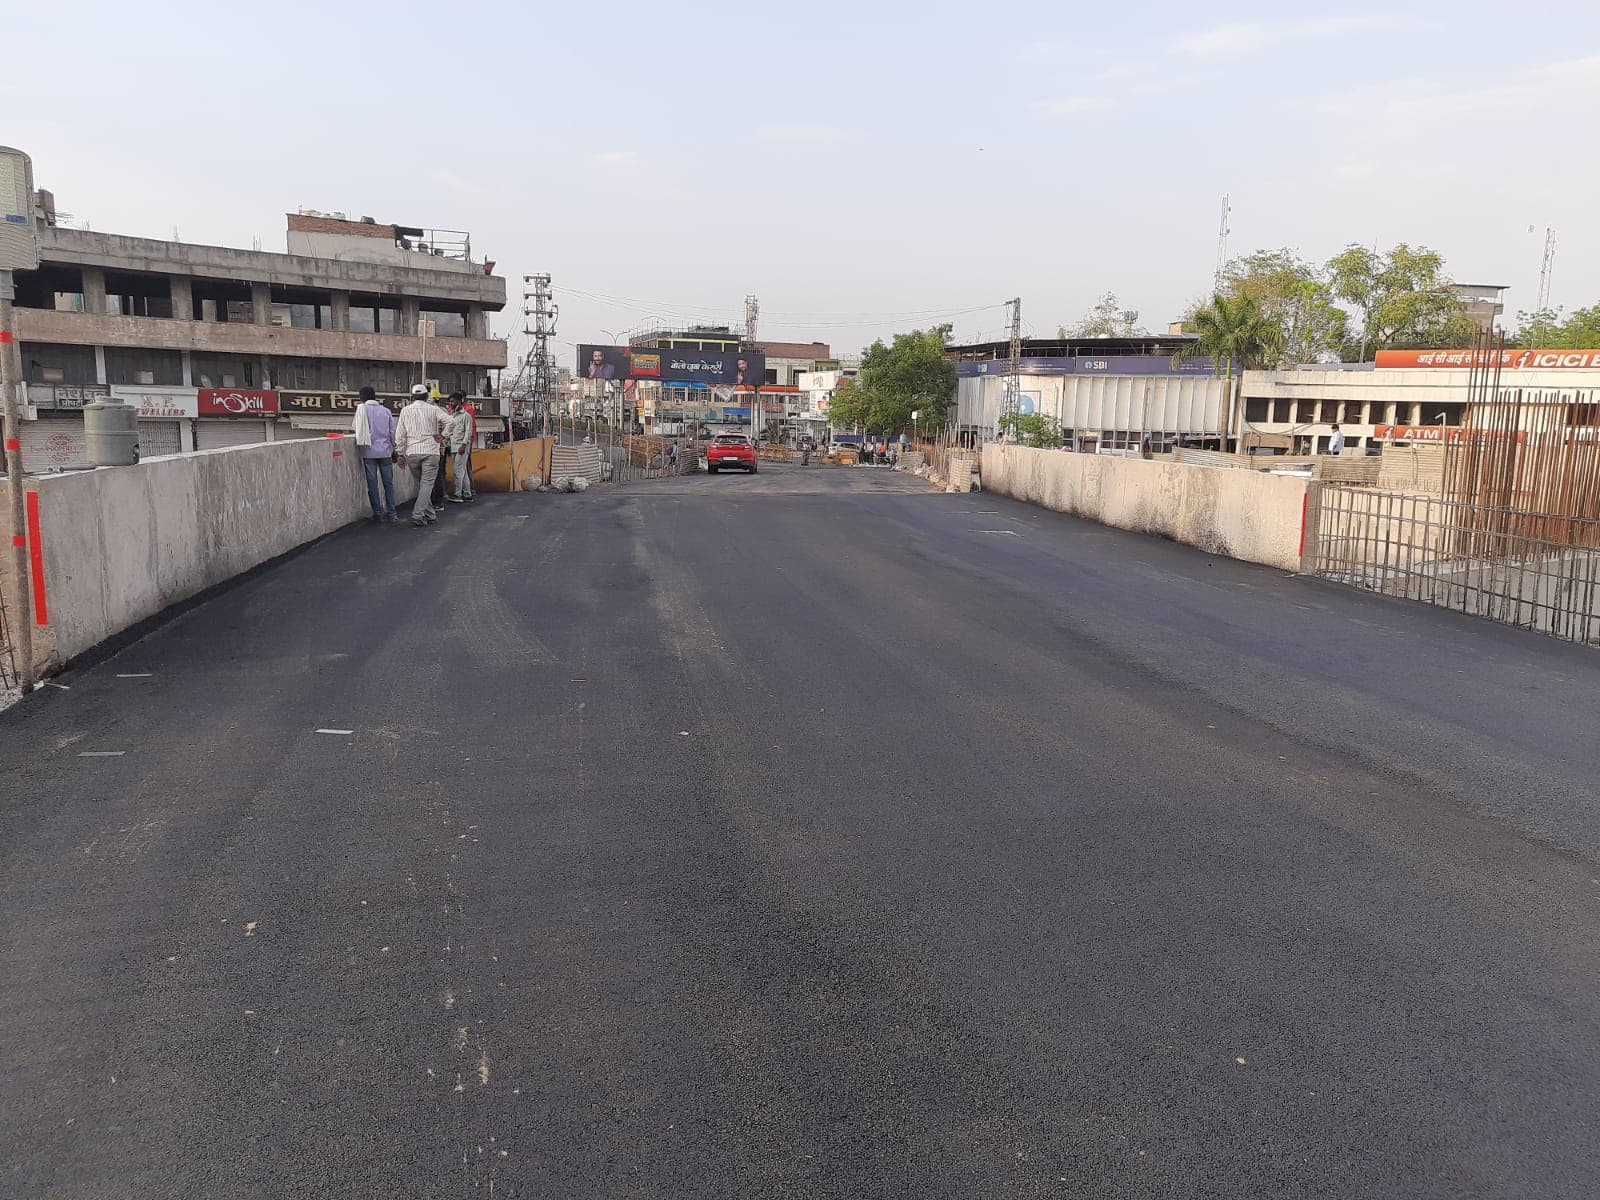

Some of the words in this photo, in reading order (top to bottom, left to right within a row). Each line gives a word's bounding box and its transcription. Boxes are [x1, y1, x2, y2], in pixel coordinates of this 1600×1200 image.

[1417, 351, 1436, 365] आई
[1436, 351, 1447, 363] सी
[1446, 352, 1466, 365] आई
[1533, 353, 1589, 367] ICICI
[1093, 360, 1107, 370] SBI
[291, 396, 322, 408] जय
[1403, 428, 1439, 439] ATM
